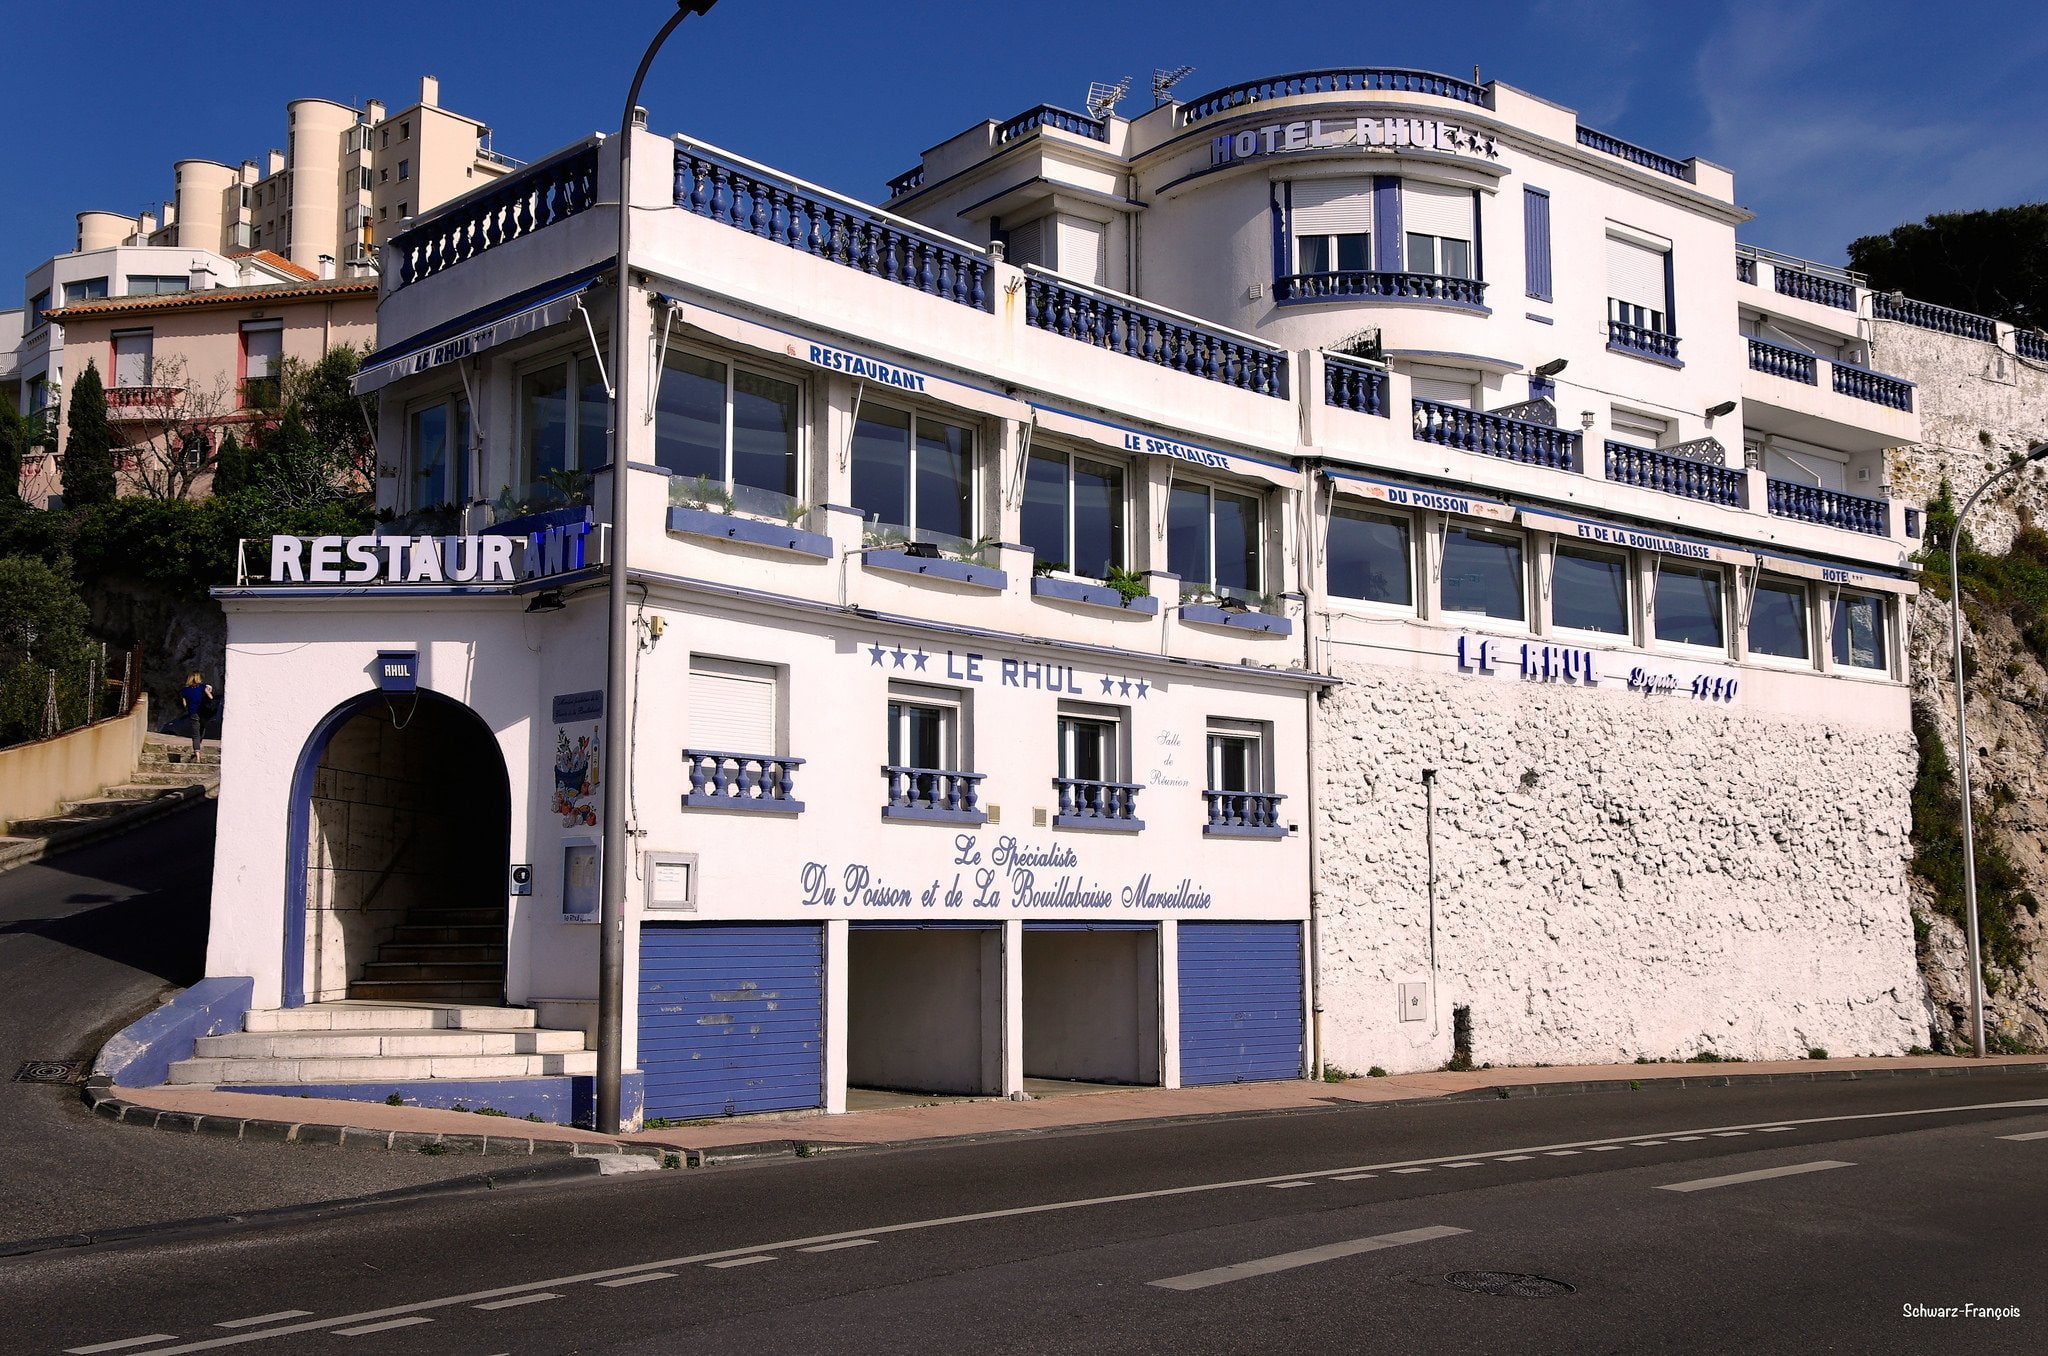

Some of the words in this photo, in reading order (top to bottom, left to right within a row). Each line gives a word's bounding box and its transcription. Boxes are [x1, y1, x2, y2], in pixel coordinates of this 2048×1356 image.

[1211, 119, 1333, 166] HOTEL
[1356, 117, 1455, 151] RHUL
[415, 350, 431, 372] LE
[434, 337, 471, 365] RHUL
[809, 344, 925, 392] RESTAURANT
[1124, 433, 1141, 451] LE
[1145, 438, 1231, 470] SPECIALISTE
[1388, 488, 1409, 503] DU
[1412, 492, 1470, 514] POISSON
[270, 521, 590, 582] RESTAURANT
[1578, 524, 1591, 537] ET
[1594, 527, 1609, 541] DE
[1612, 530, 1627, 544] LA
[1629, 533, 1710, 559] BOUILLABAISSE
[384, 664, 410, 677] RHUL
[947, 650, 984, 682] LE
[1002, 658, 1083, 695] RHUL
[1458, 635, 1500, 671] LE
[1521, 643, 1600, 683] RHUL
[1157, 729, 1181, 746] Salle
[1149, 769, 1189, 787] Réunion
[1163, 753, 1174, 766] de
[954, 834, 982, 866] Le
[992, 835, 1078, 877] Spécialiste
[801, 861, 836, 907] Du
[843, 863, 913, 907] Poisson
[921, 879, 940, 907] et
[944, 873, 964, 907] de
[972, 867, 1001, 908] La
[1011, 867, 1113, 909] Bouillabaisse
[1121, 873, 1212, 910] Marseillaise
